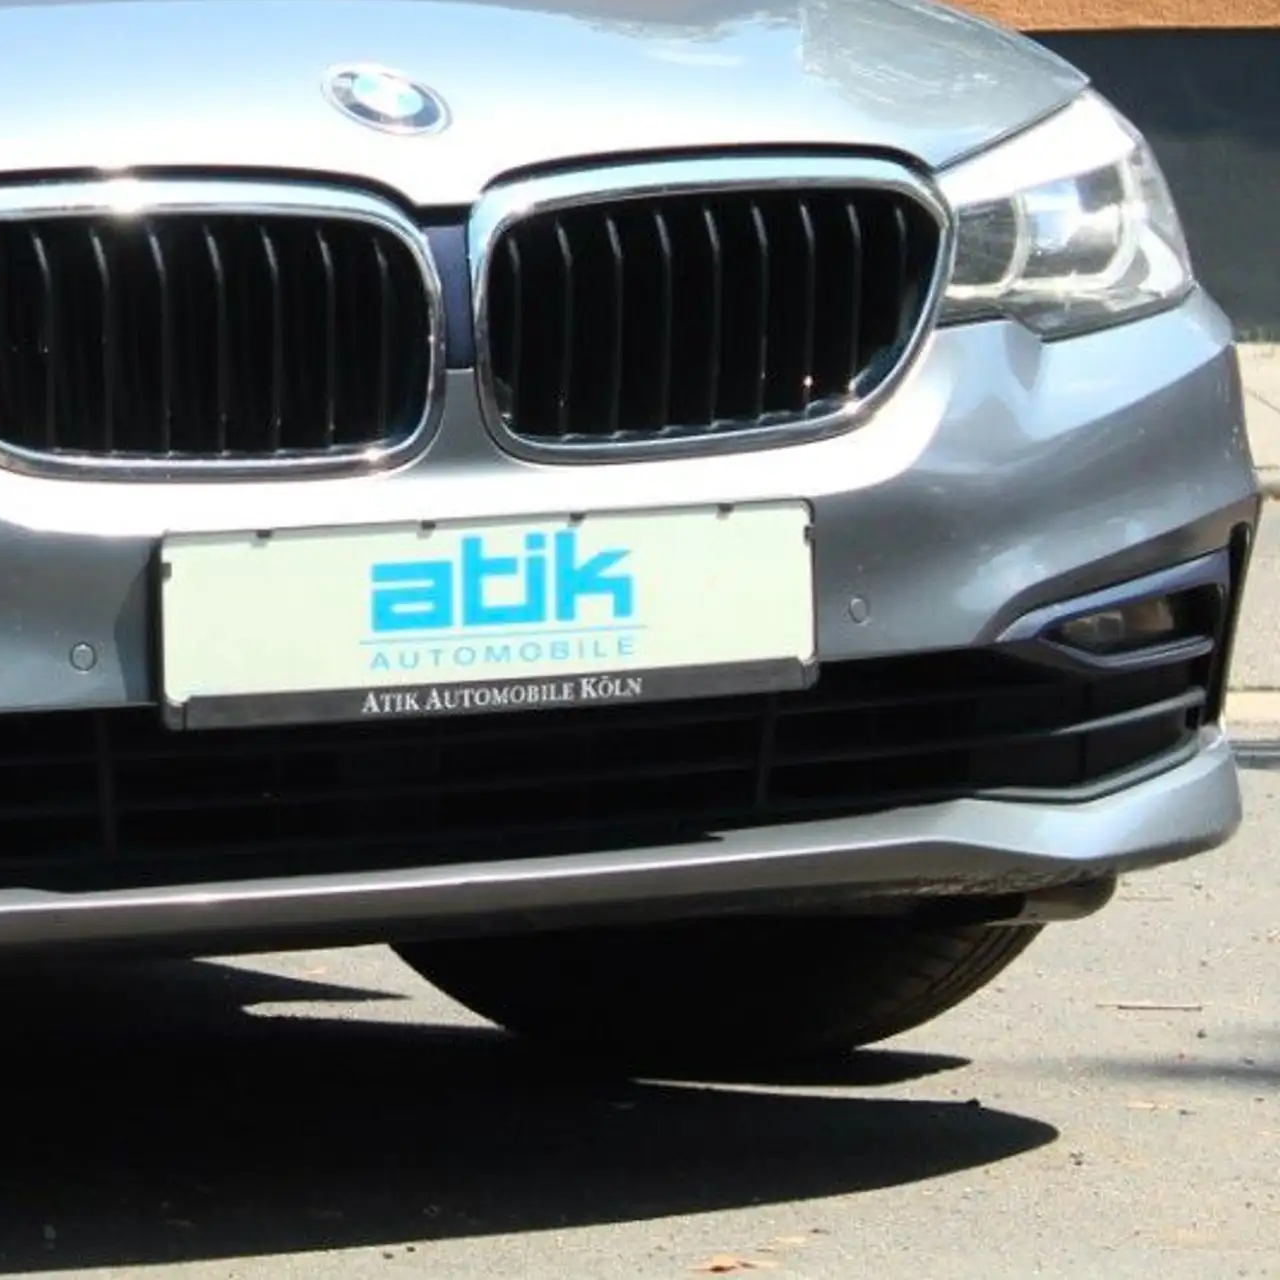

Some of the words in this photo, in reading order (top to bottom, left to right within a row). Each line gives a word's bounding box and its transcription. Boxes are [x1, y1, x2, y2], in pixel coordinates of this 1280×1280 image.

[371, 528, 634, 631] atik
[370, 638, 634, 670] AUTOMOBILE
[362, 691, 420, 714] ATIK
[425, 681, 574, 711] AUTOMOBILE
[580, 675, 643, 699] KÖLN
